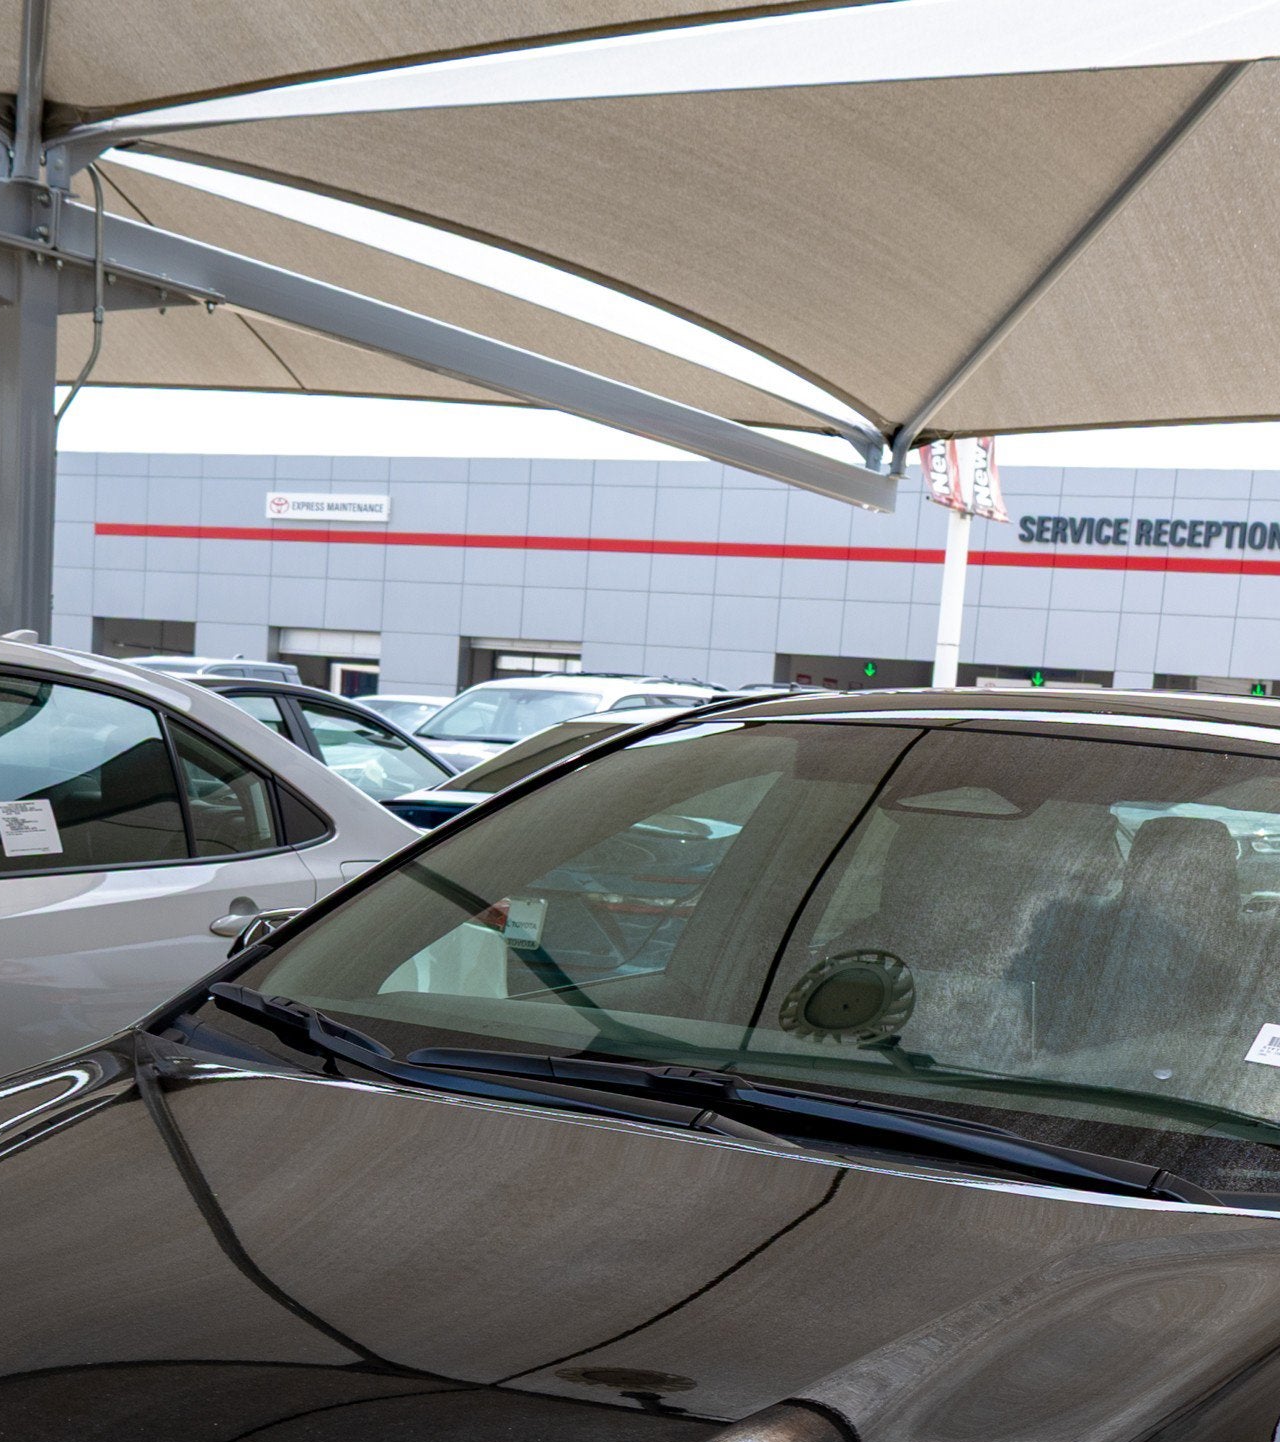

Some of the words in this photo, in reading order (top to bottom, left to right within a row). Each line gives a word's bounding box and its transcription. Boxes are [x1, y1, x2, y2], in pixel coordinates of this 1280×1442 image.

[292, 501, 325, 512] EXPRESS
[326, 502, 384, 513] MAINTENANCE
[1018, 515, 1129, 546] SERVICE
